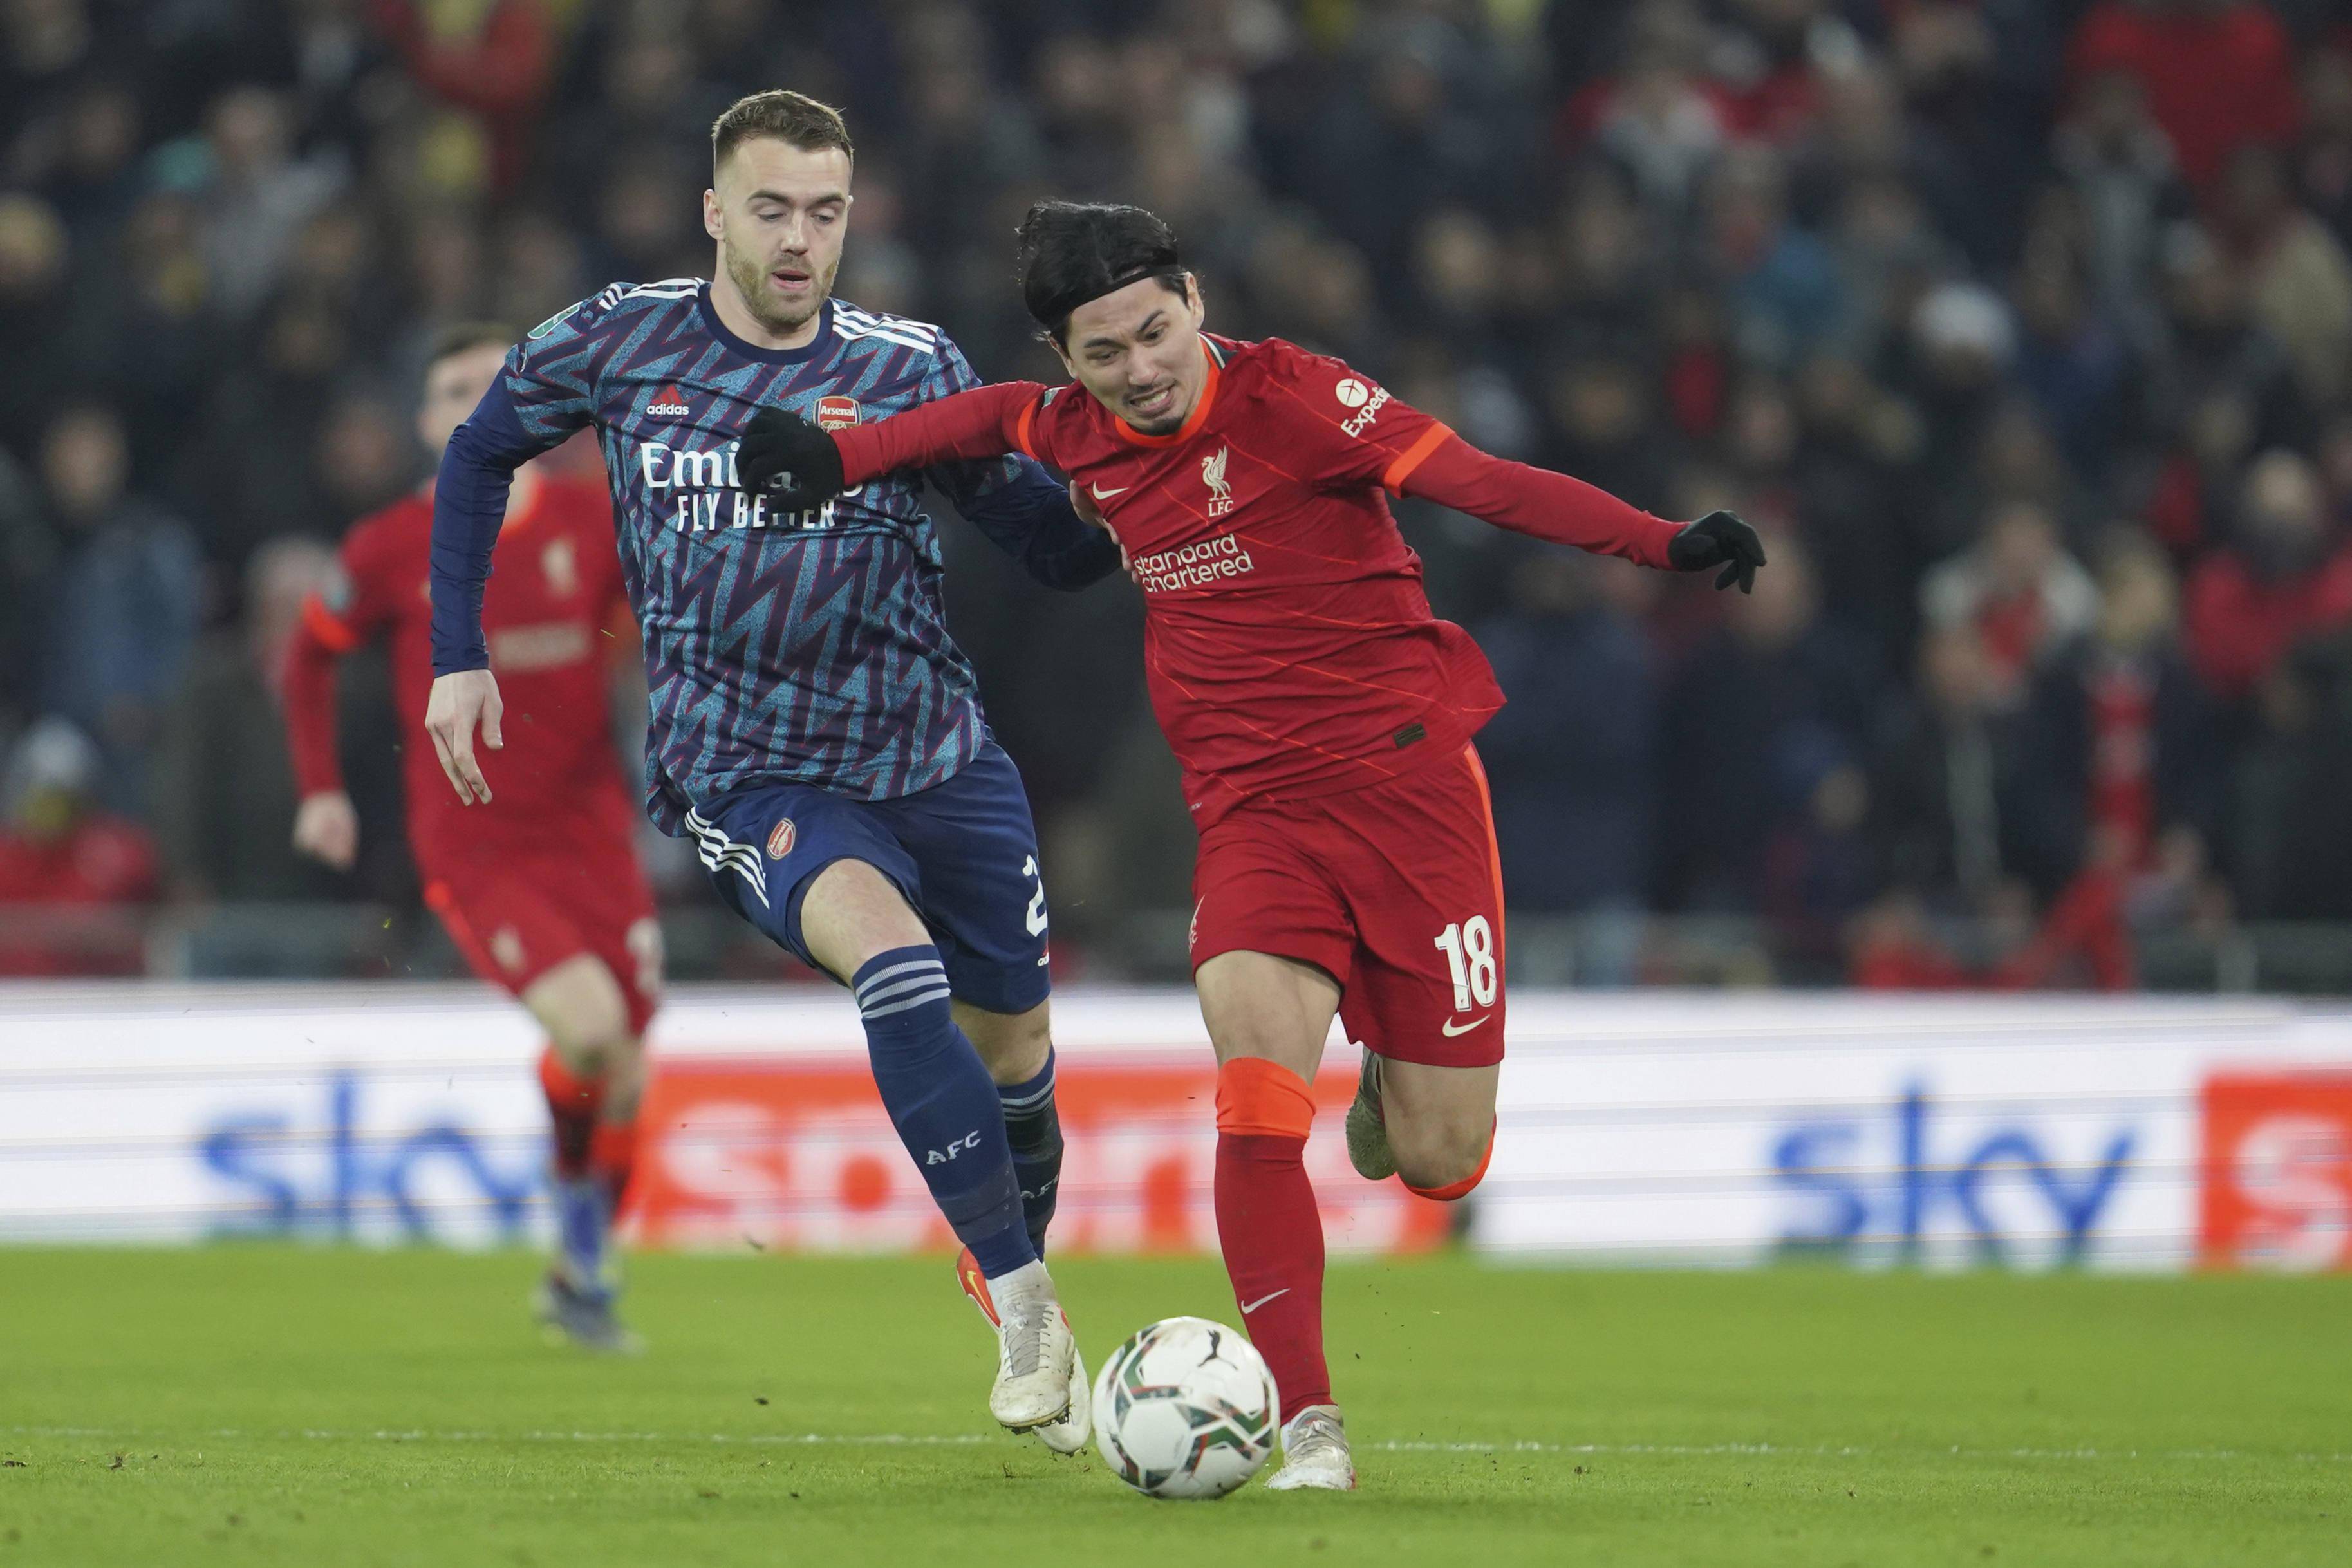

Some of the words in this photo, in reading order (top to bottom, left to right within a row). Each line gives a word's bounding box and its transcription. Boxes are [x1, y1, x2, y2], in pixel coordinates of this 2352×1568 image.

[646, 404, 689, 415] adidas
[819, 405, 855, 417] Arsenal
[1340, 386, 1390, 438] Exped
[677, 493, 722, 532] FLY
[1208, 501, 1234, 516] LFC
[1134, 534, 1239, 575] standard
[1143, 550, 1255, 593] chartered
[1434, 915, 1497, 1012] 18
[926, 1130, 981, 1165] AFC
[1770, 1083, 2137, 1263] sky
